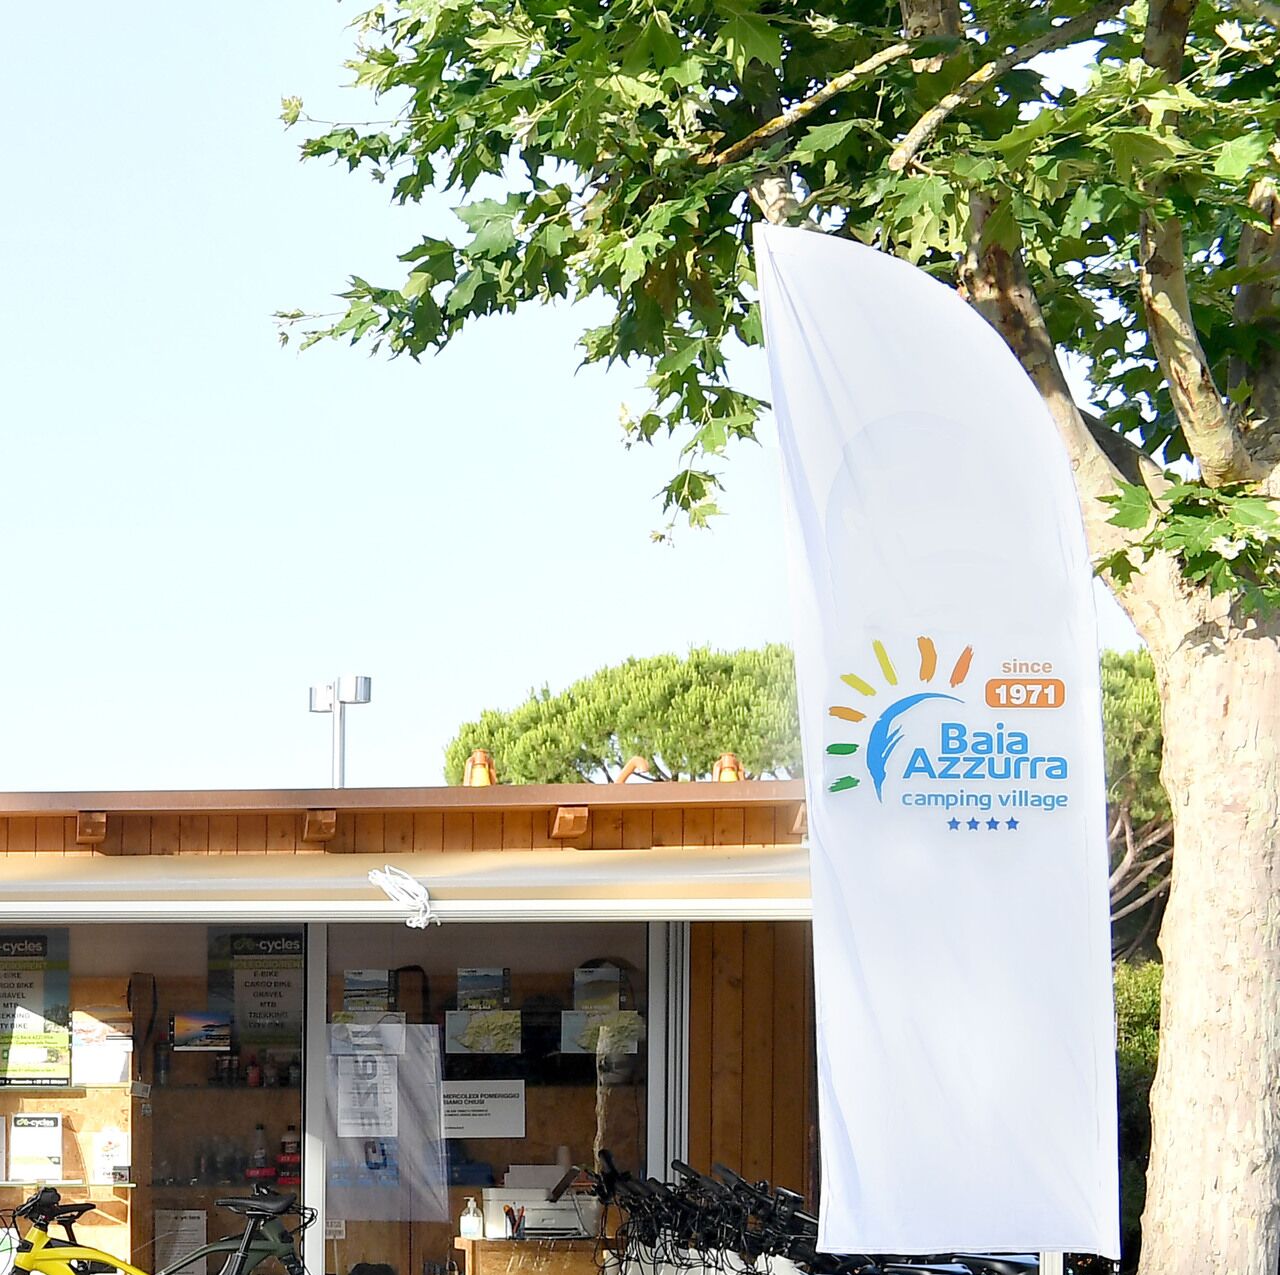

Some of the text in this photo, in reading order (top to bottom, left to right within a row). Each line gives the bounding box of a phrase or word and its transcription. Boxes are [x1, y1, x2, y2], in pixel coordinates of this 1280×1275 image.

[1002, 659, 1053, 674] since
[995, 684, 1056, 705] 1971
[941, 723, 1029, 755] Baia
[902, 748, 1068, 780] Azzurra
[901, 790, 1068, 811] camping village
